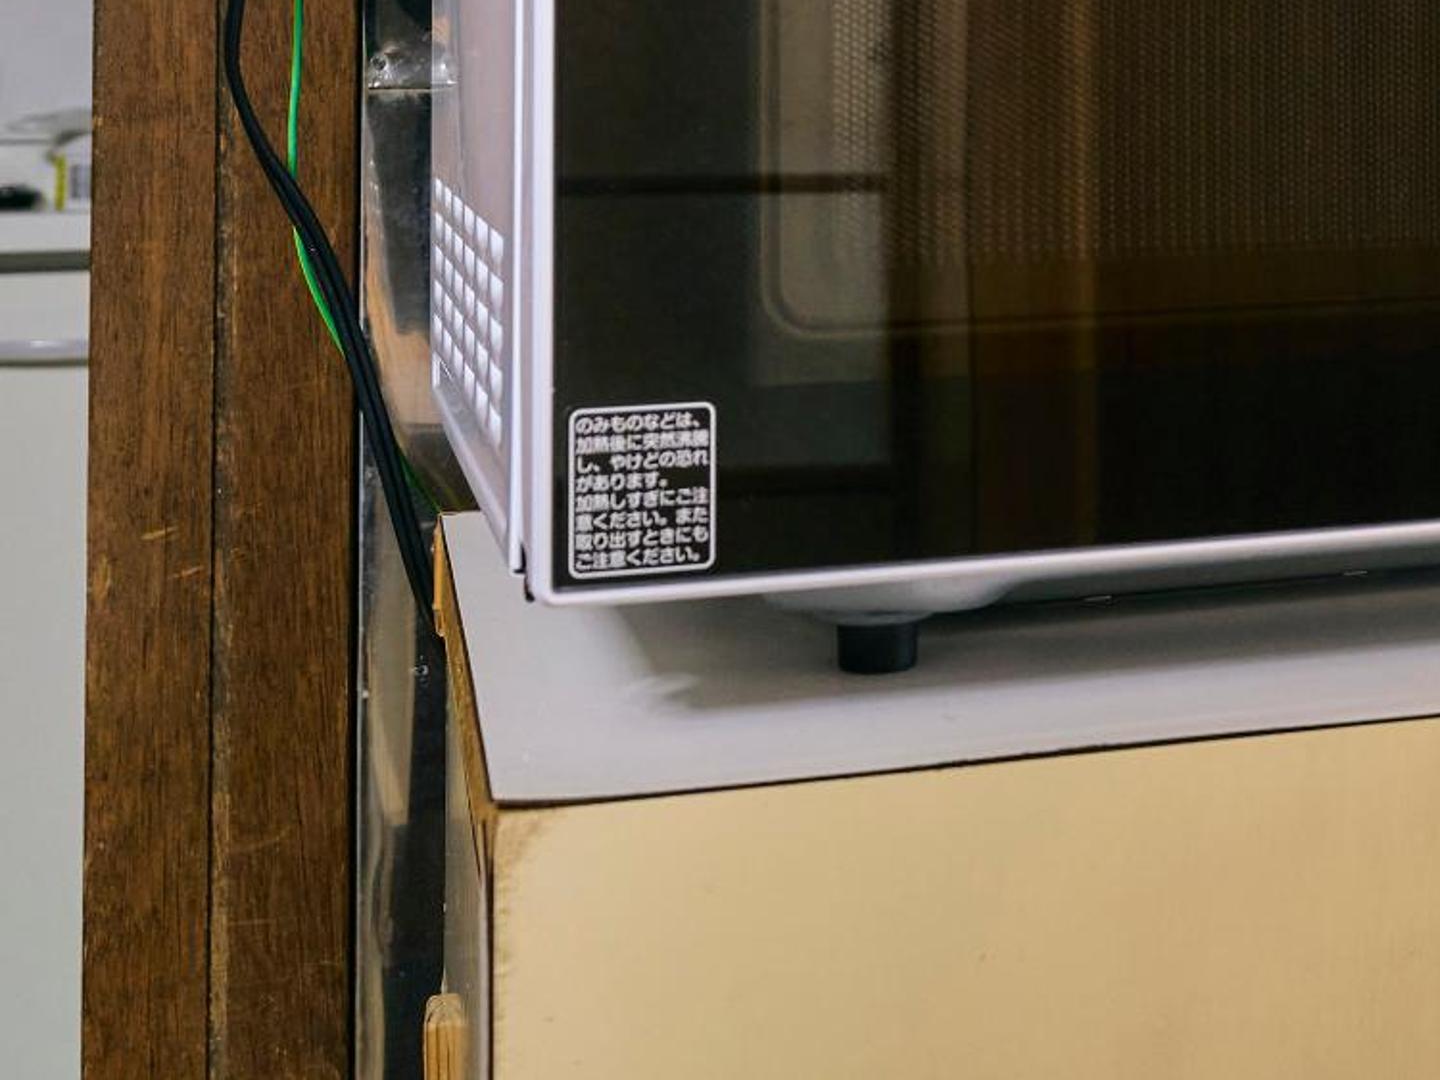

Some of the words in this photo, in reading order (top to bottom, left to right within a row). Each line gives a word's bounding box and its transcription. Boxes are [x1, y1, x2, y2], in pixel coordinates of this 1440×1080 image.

[576, 411, 701, 434] のみものなどは、
[577, 450, 709, 474] し、やけどの恐れ
[575, 471, 669, 493] があります。
[575, 487, 709, 512] 加熱しすぎにご注
[575, 507, 709, 532] 意ください。また
[575, 526, 709, 551] 取り出すときにも
[575, 546, 701, 570] ご注意ください。
